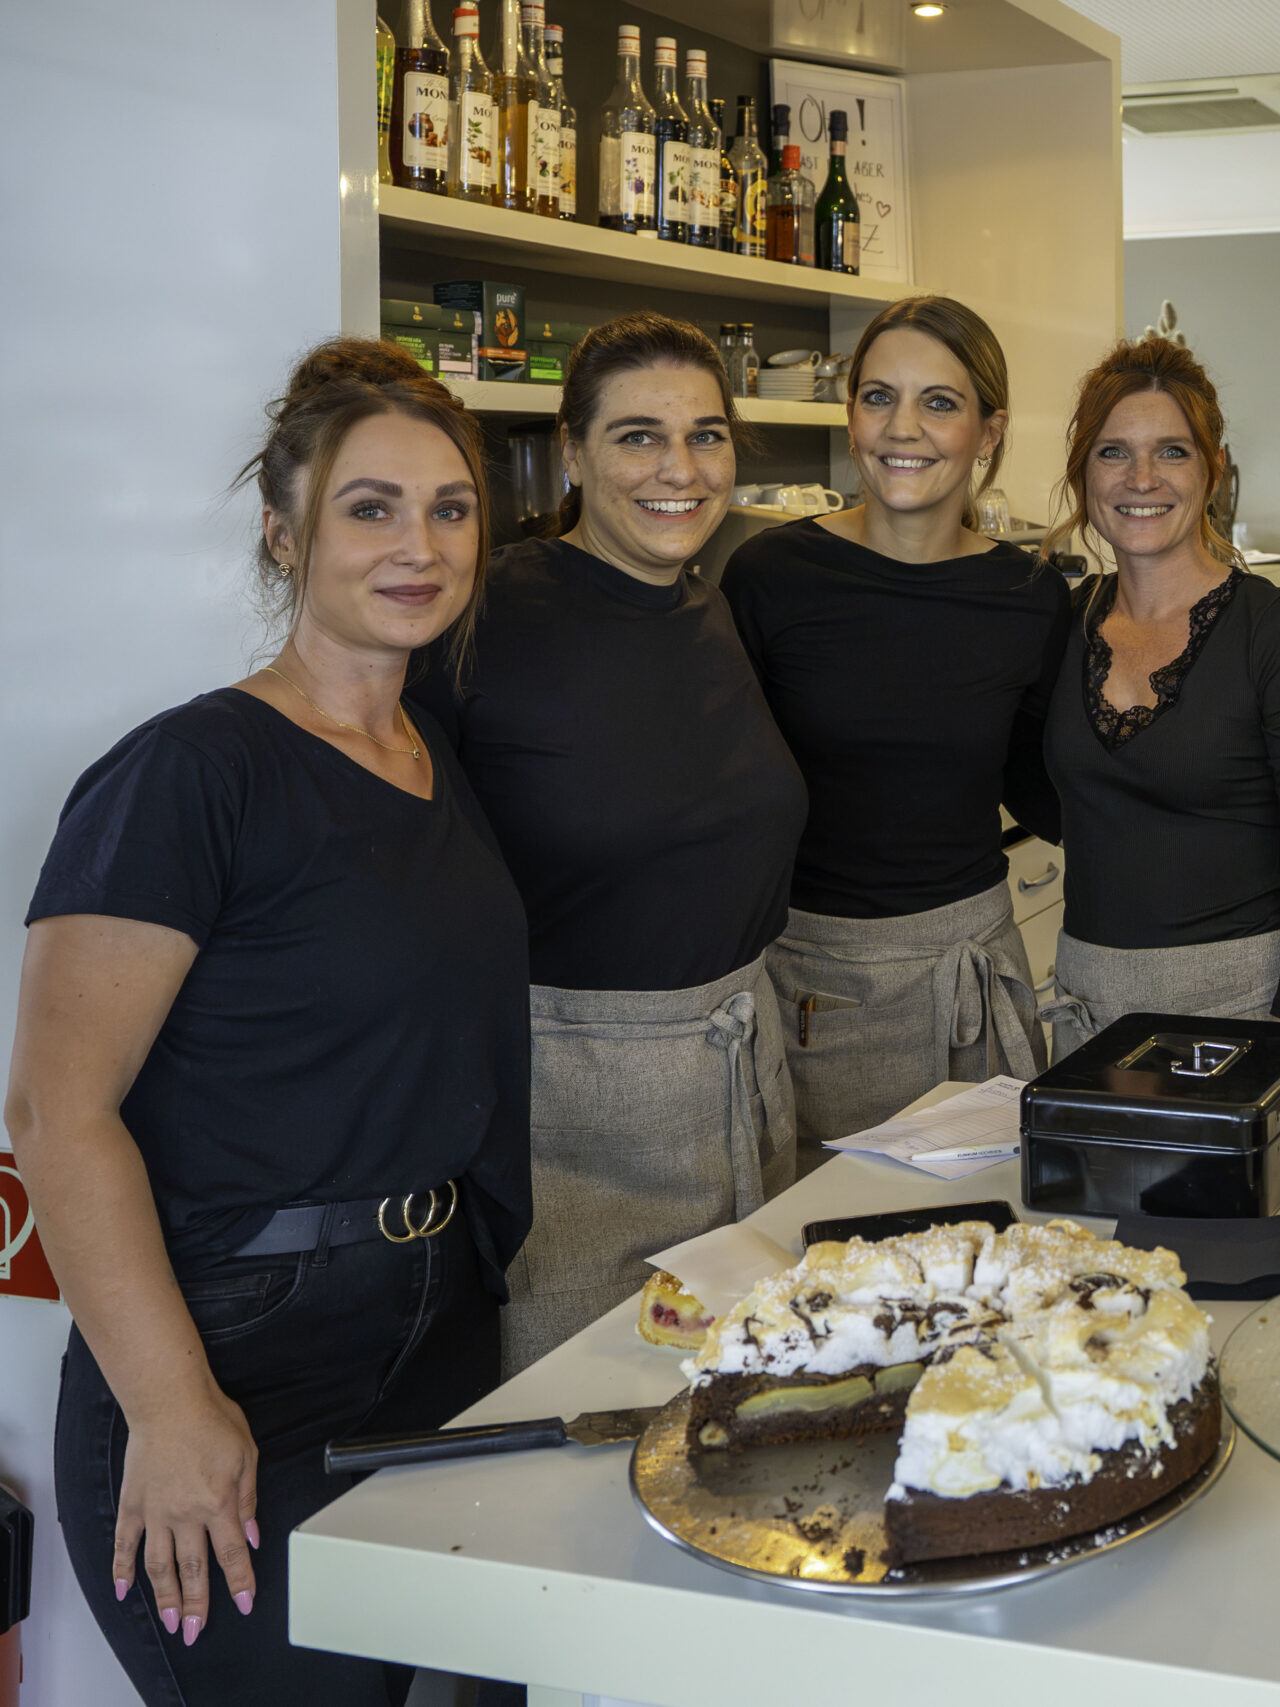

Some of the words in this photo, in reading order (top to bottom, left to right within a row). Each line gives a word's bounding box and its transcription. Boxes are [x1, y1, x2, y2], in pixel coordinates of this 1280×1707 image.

[416, 86, 448, 100] MON
[474, 106, 491, 118] MO
[693, 159, 720, 170] MON
[854, 158, 885, 178] ABER
[496, 292, 516, 306] pure
